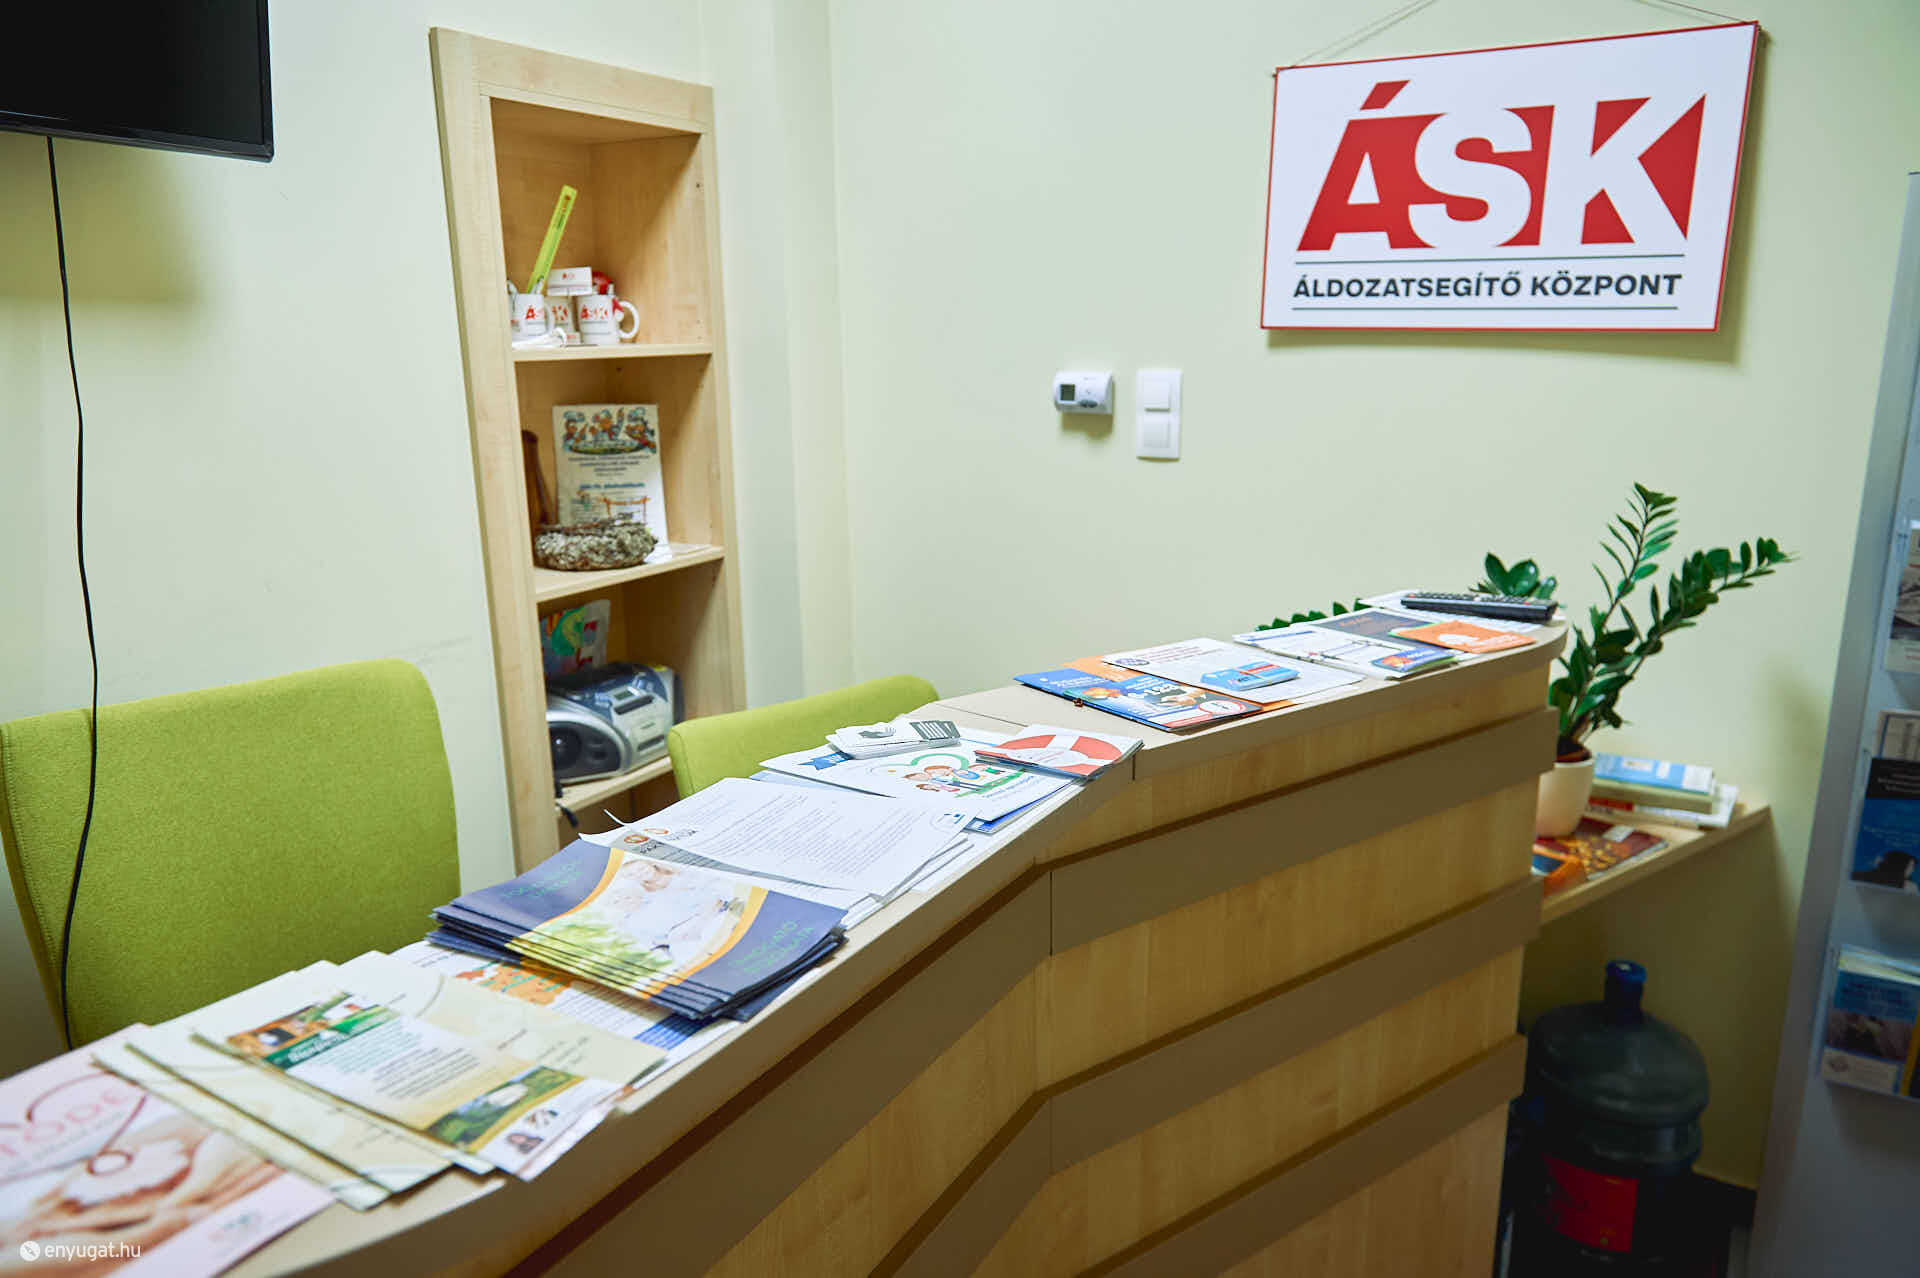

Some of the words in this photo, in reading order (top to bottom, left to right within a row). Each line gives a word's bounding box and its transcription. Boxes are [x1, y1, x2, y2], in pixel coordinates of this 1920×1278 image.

[1297, 81, 1706, 251] ÁSK
[1294, 271, 1521, 298] ÁLDOZATSEGÍTŐ
[1531, 270, 1682, 297] KÖZPONT
